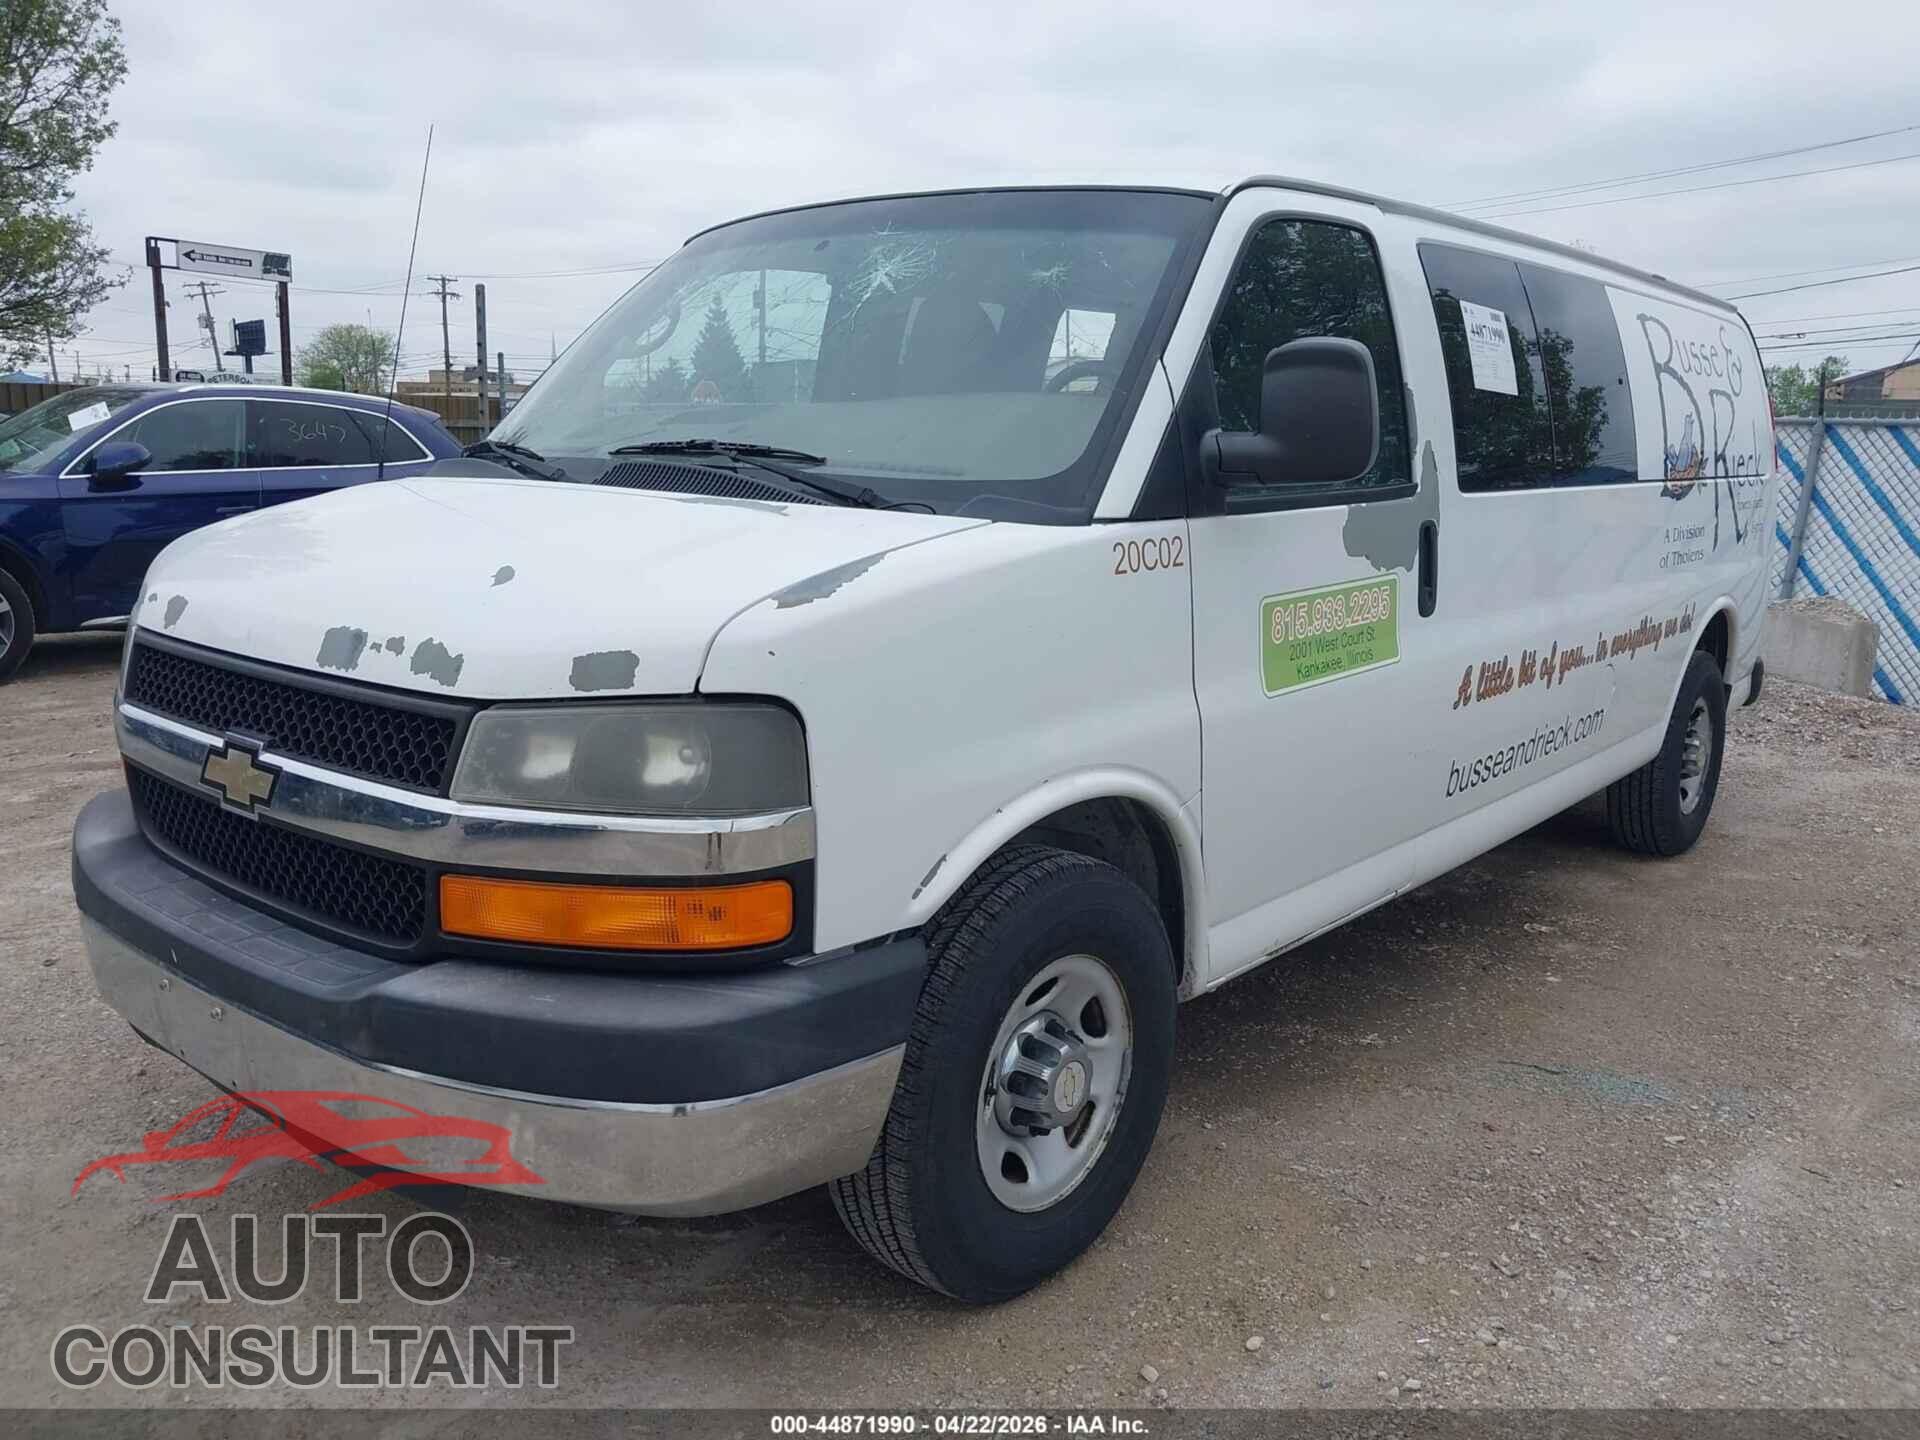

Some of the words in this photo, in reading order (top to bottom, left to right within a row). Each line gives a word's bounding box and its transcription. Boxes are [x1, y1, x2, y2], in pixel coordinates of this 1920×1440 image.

[1719, 325, 1743, 398] &
[207, 373, 253, 385] PETERSO
[279, 417, 346, 442] 3647
[1663, 528, 1671, 544] A
[1673, 524, 1705, 542] Division
[1112, 535, 1184, 575] 20C02
[1659, 552, 1670, 569] of
[1271, 585, 1391, 645] 815.933.2295
[1289, 641, 1312, 662] 2001
[1315, 635, 1339, 655] West
[1341, 629, 1365, 649] Court
[1345, 647, 1375, 667] Illinois
[1453, 664, 1473, 710] A
[1476, 654, 1515, 702] little
[1518, 649, 1537, 689] bit
[1540, 640, 1558, 689] of
[1595, 632, 1608, 662] in
[1610, 615, 1663, 660] everything
[1664, 617, 1678, 639] we
[1445, 708, 1604, 798] busseandrieck.com
